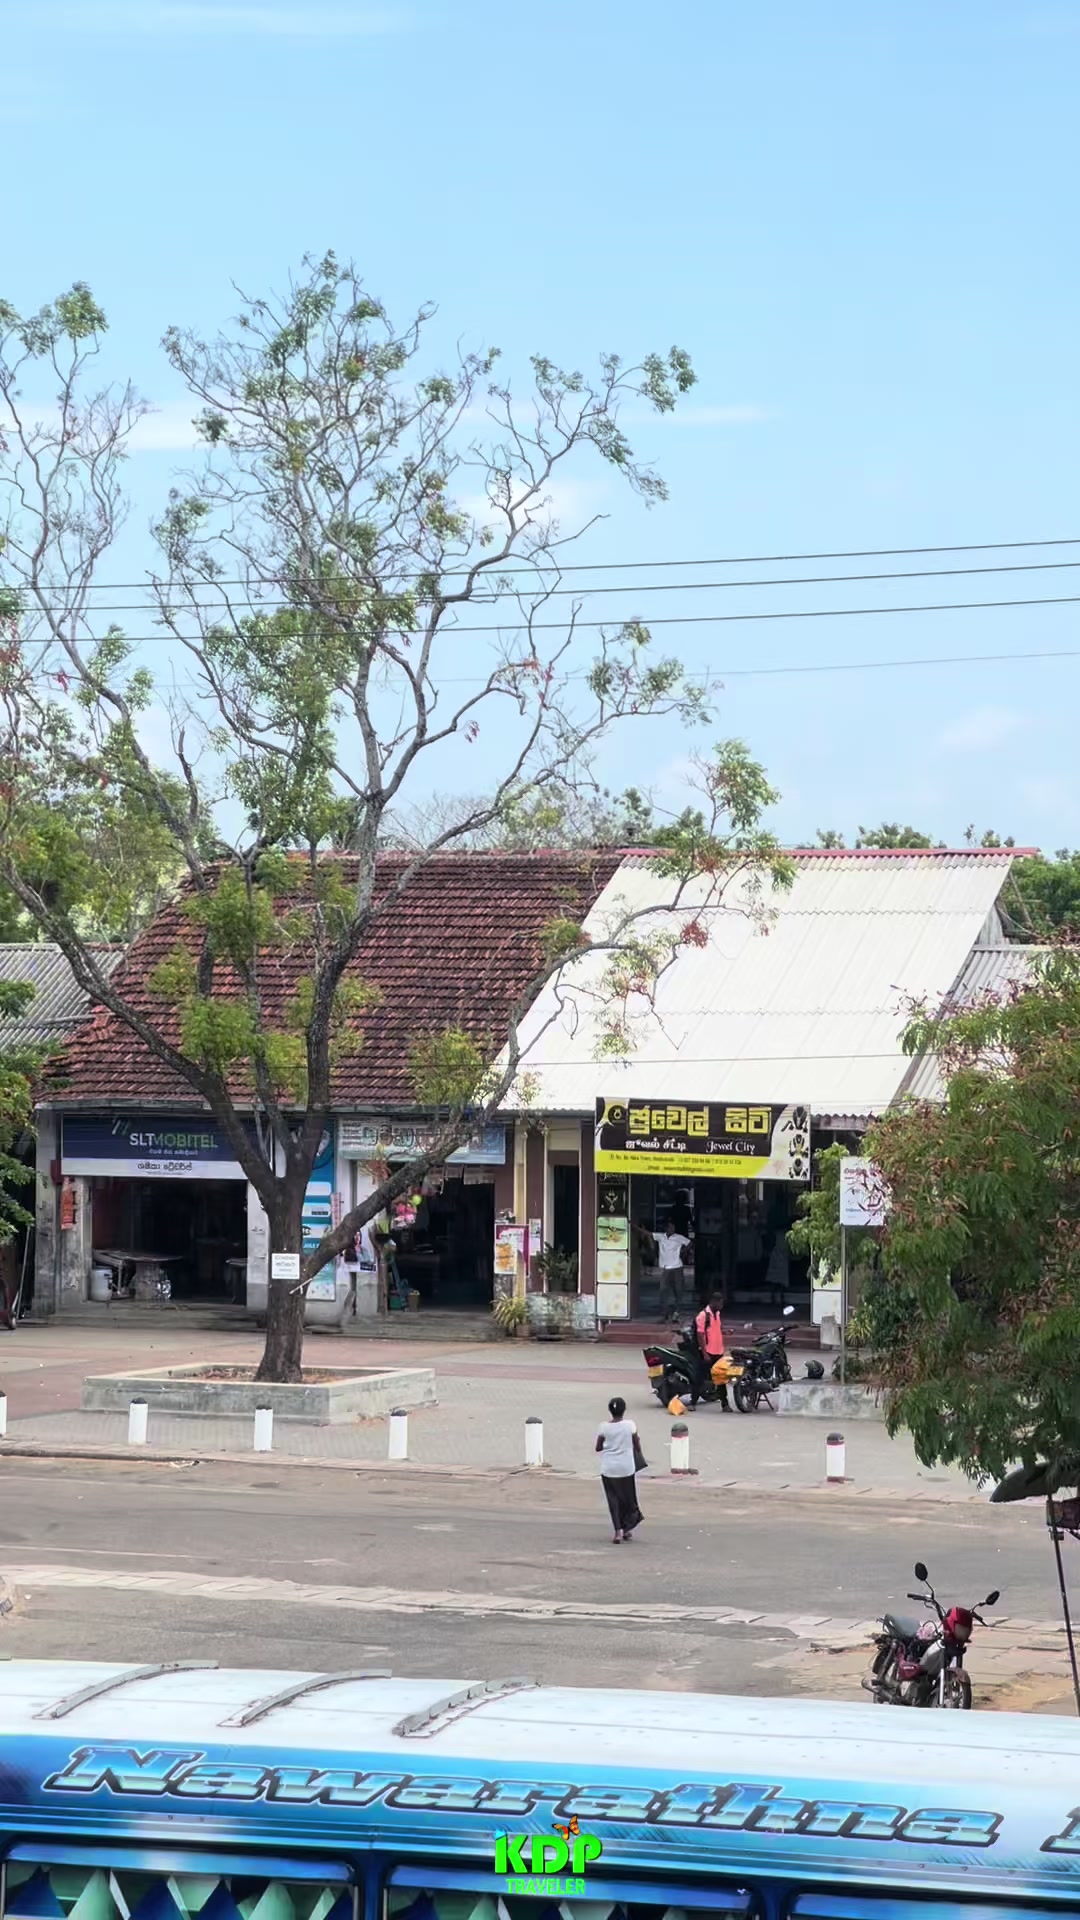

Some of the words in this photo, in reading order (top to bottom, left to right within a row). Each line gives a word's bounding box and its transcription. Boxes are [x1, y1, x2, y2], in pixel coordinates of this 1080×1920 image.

[629, 1105, 709, 1137] ජුවෙල්
[129, 1132, 218, 1149] SLTMOBITEL
[705, 1140, 733, 1153] Jewel
[735, 1141, 756, 1155] City
[40, 1745, 1004, 1850] Nawarathna
